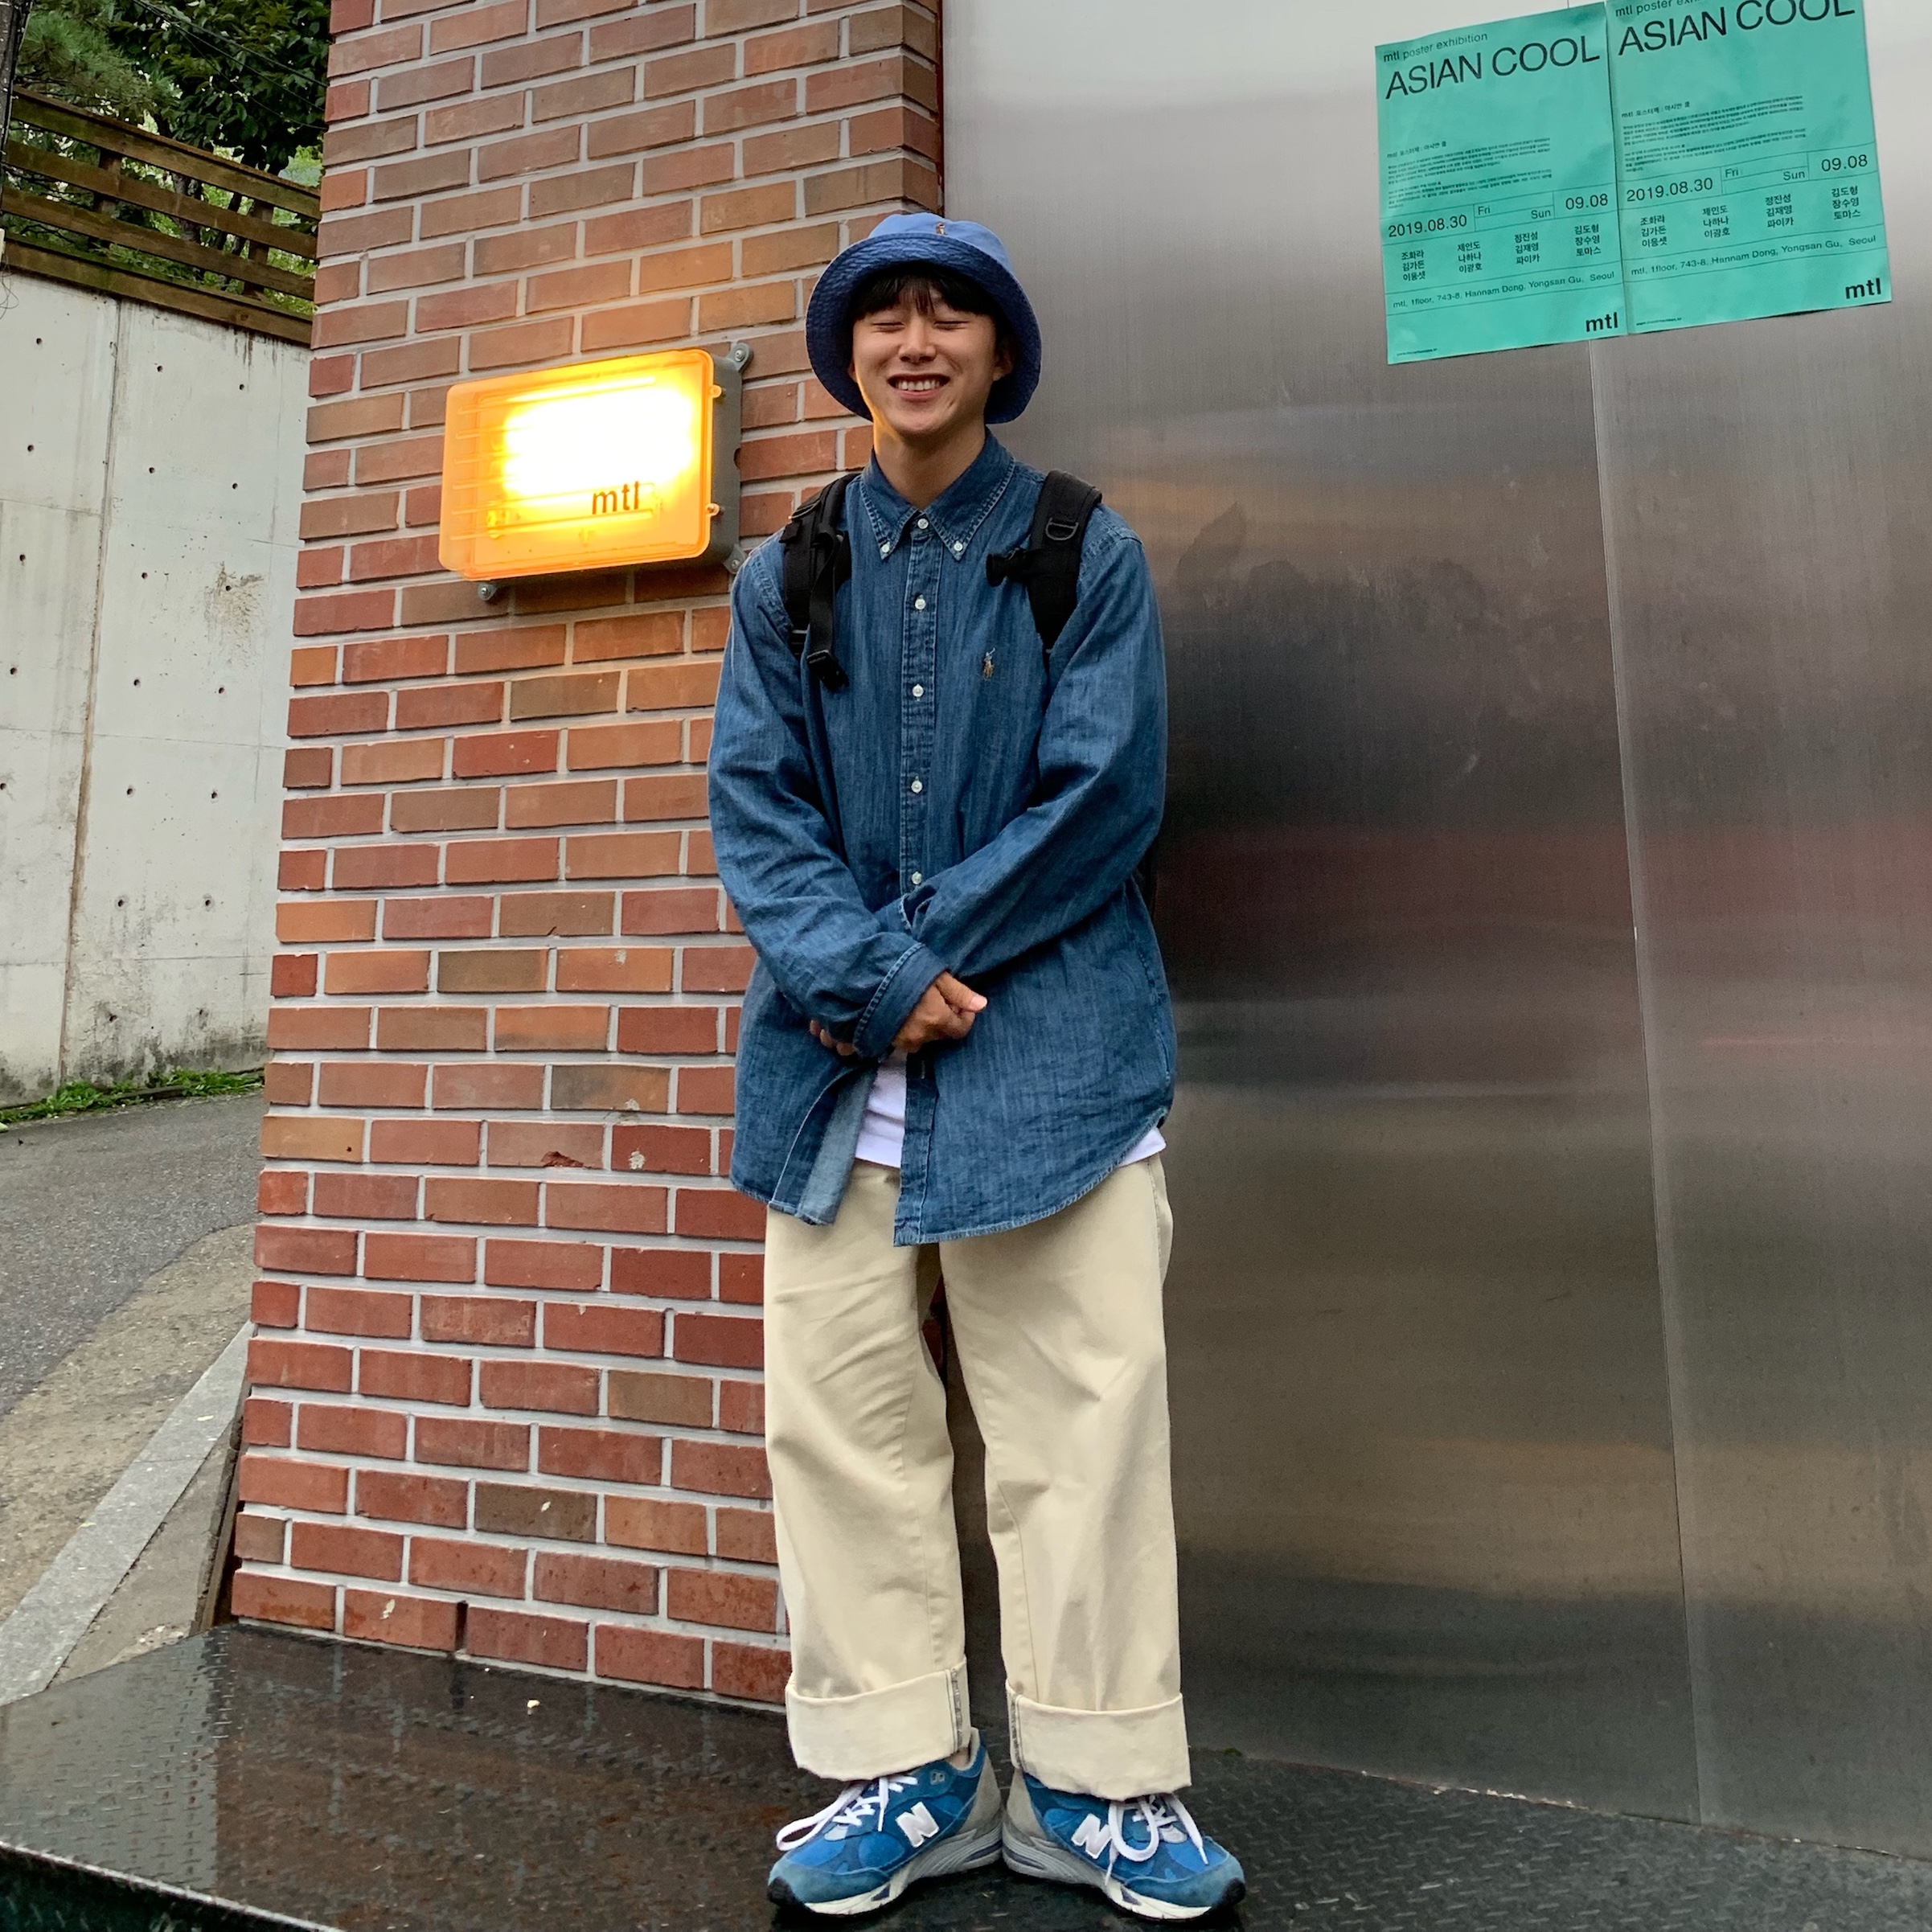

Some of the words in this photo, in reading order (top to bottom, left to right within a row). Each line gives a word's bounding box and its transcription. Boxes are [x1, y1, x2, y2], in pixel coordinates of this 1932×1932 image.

[1615, 5, 1633, 18] mtl
[1636, 0, 1672, 16] poster
[1618, 6, 1727, 55] ASIAN
[1736, 0, 1856, 31] COOL
[1384, 51, 1401, 63] mtl
[1402, 45, 1434, 59] poster
[1436, 32, 1488, 51] exhibition
[1385, 52, 1482, 100] ASIAN
[1491, 35, 1600, 77] COOL
[1626, 177, 1713, 202] 2019.08.30
[1725, 167, 1740, 178] Fri
[1782, 170, 1806, 181] Sun
[1821, 154, 1868, 173] 09.08
[1388, 214, 1468, 238] 2019.08.30
[1478, 206, 1491, 215] Fri
[1531, 210, 1552, 219] Sun
[1565, 193, 1609, 211] 09.08
[1767, 217, 1795, 228] 파이카
[1833, 209, 1861, 220] 토마스
[1640, 225, 1667, 238] 김가든
[1575, 246, 1602, 257] 토마스
[1711, 253, 1750, 265] Hannam
[1751, 248, 1779, 259] Dong,
[1780, 241, 1823, 256] Yongsan
[1824, 240, 1844, 249] Gu,
[1848, 235, 1877, 247] Seoul
[1465, 286, 1500, 298] Hannam
[1502, 282, 1527, 294] Dong,
[1528, 276, 1566, 290] Yongsan
[1589, 270, 1615, 281] Seoul
[1844, 277, 1882, 299] mtl
[1585, 311, 1619, 333] mtl
[592, 481, 640, 515] mtl
[896, 1802, 940, 1848] N
[1071, 1813, 1114, 1860] N
